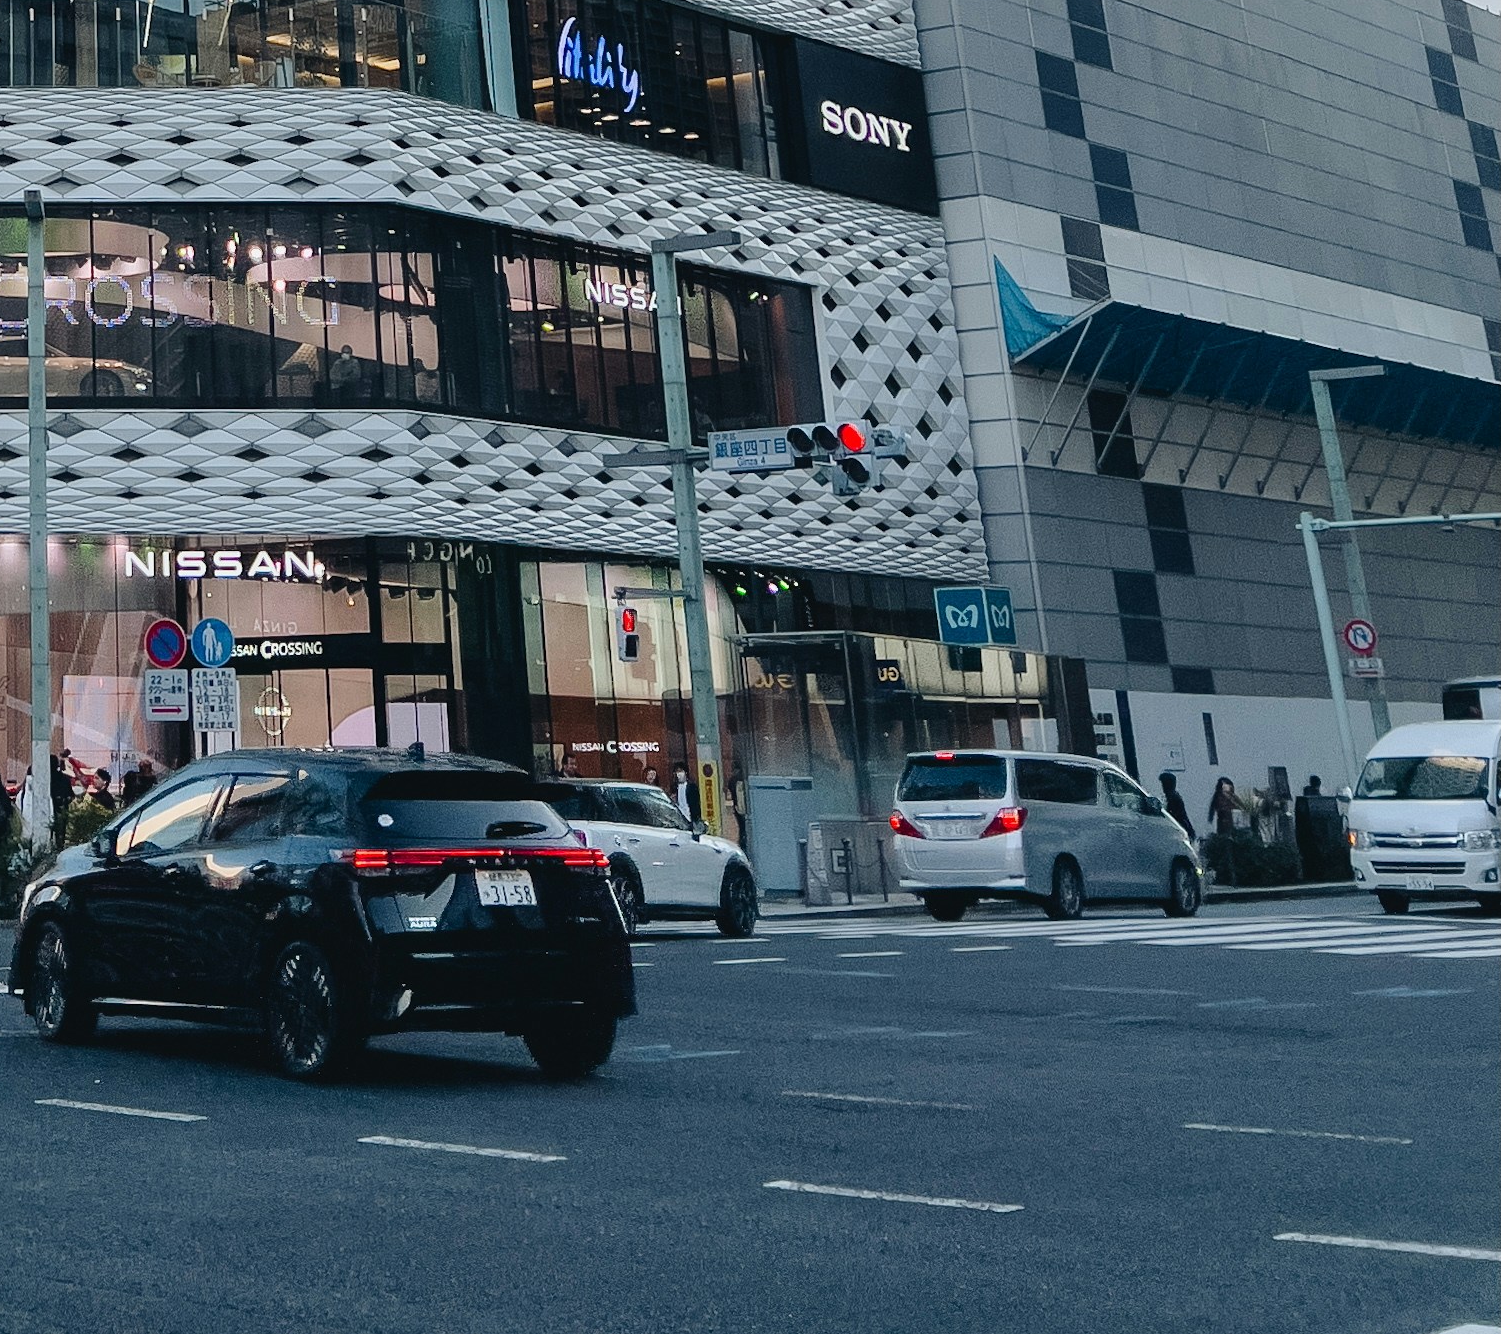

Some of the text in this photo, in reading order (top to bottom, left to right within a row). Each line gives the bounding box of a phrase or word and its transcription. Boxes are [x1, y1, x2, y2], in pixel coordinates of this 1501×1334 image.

[821, 100, 912, 152] SONY
[585, 278, 682, 316] NISS
[715, 437, 787, 458] 銀座四丁目
[760, 456, 766, 465] 4
[125, 550, 314, 577] NISSAN
[230, 641, 323, 659] SSAN CROSSING
[572, 741, 660, 754] NISSAN CROSSING
